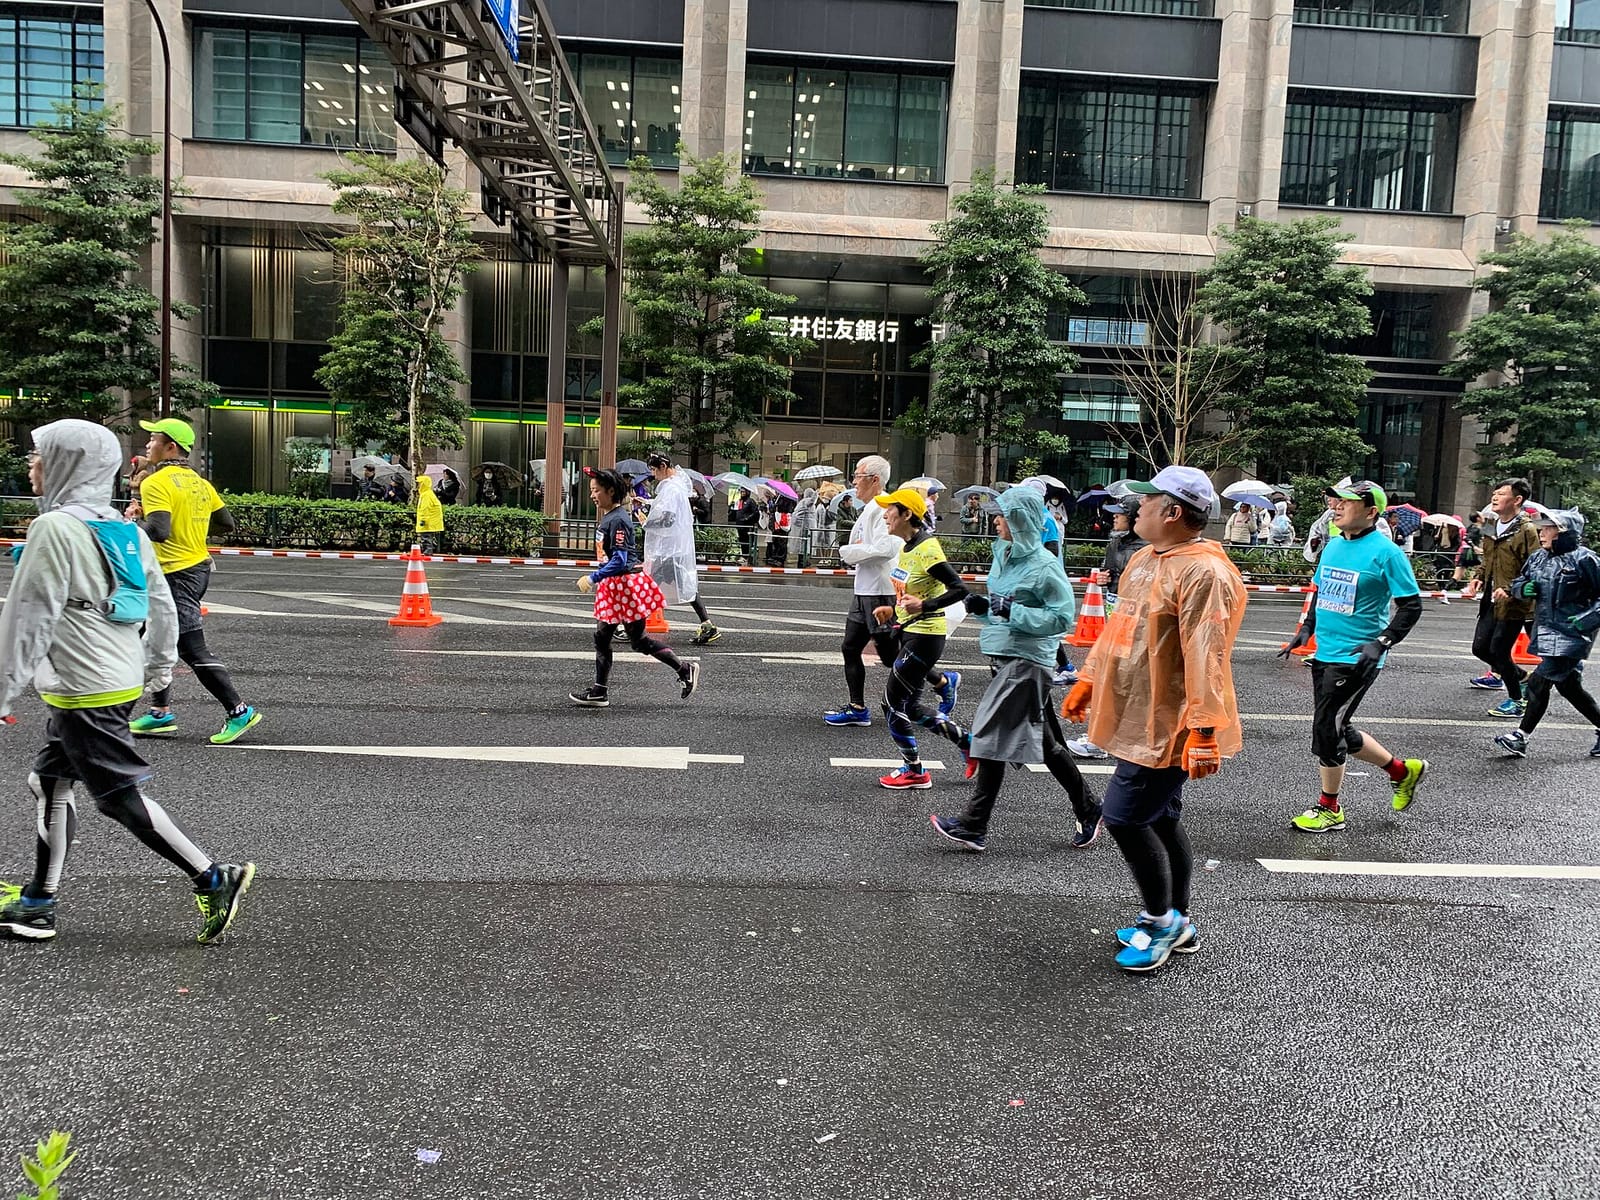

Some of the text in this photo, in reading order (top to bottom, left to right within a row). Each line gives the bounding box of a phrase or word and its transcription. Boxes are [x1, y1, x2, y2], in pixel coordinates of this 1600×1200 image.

[768, 315, 899, 342] 三井住友銀行
